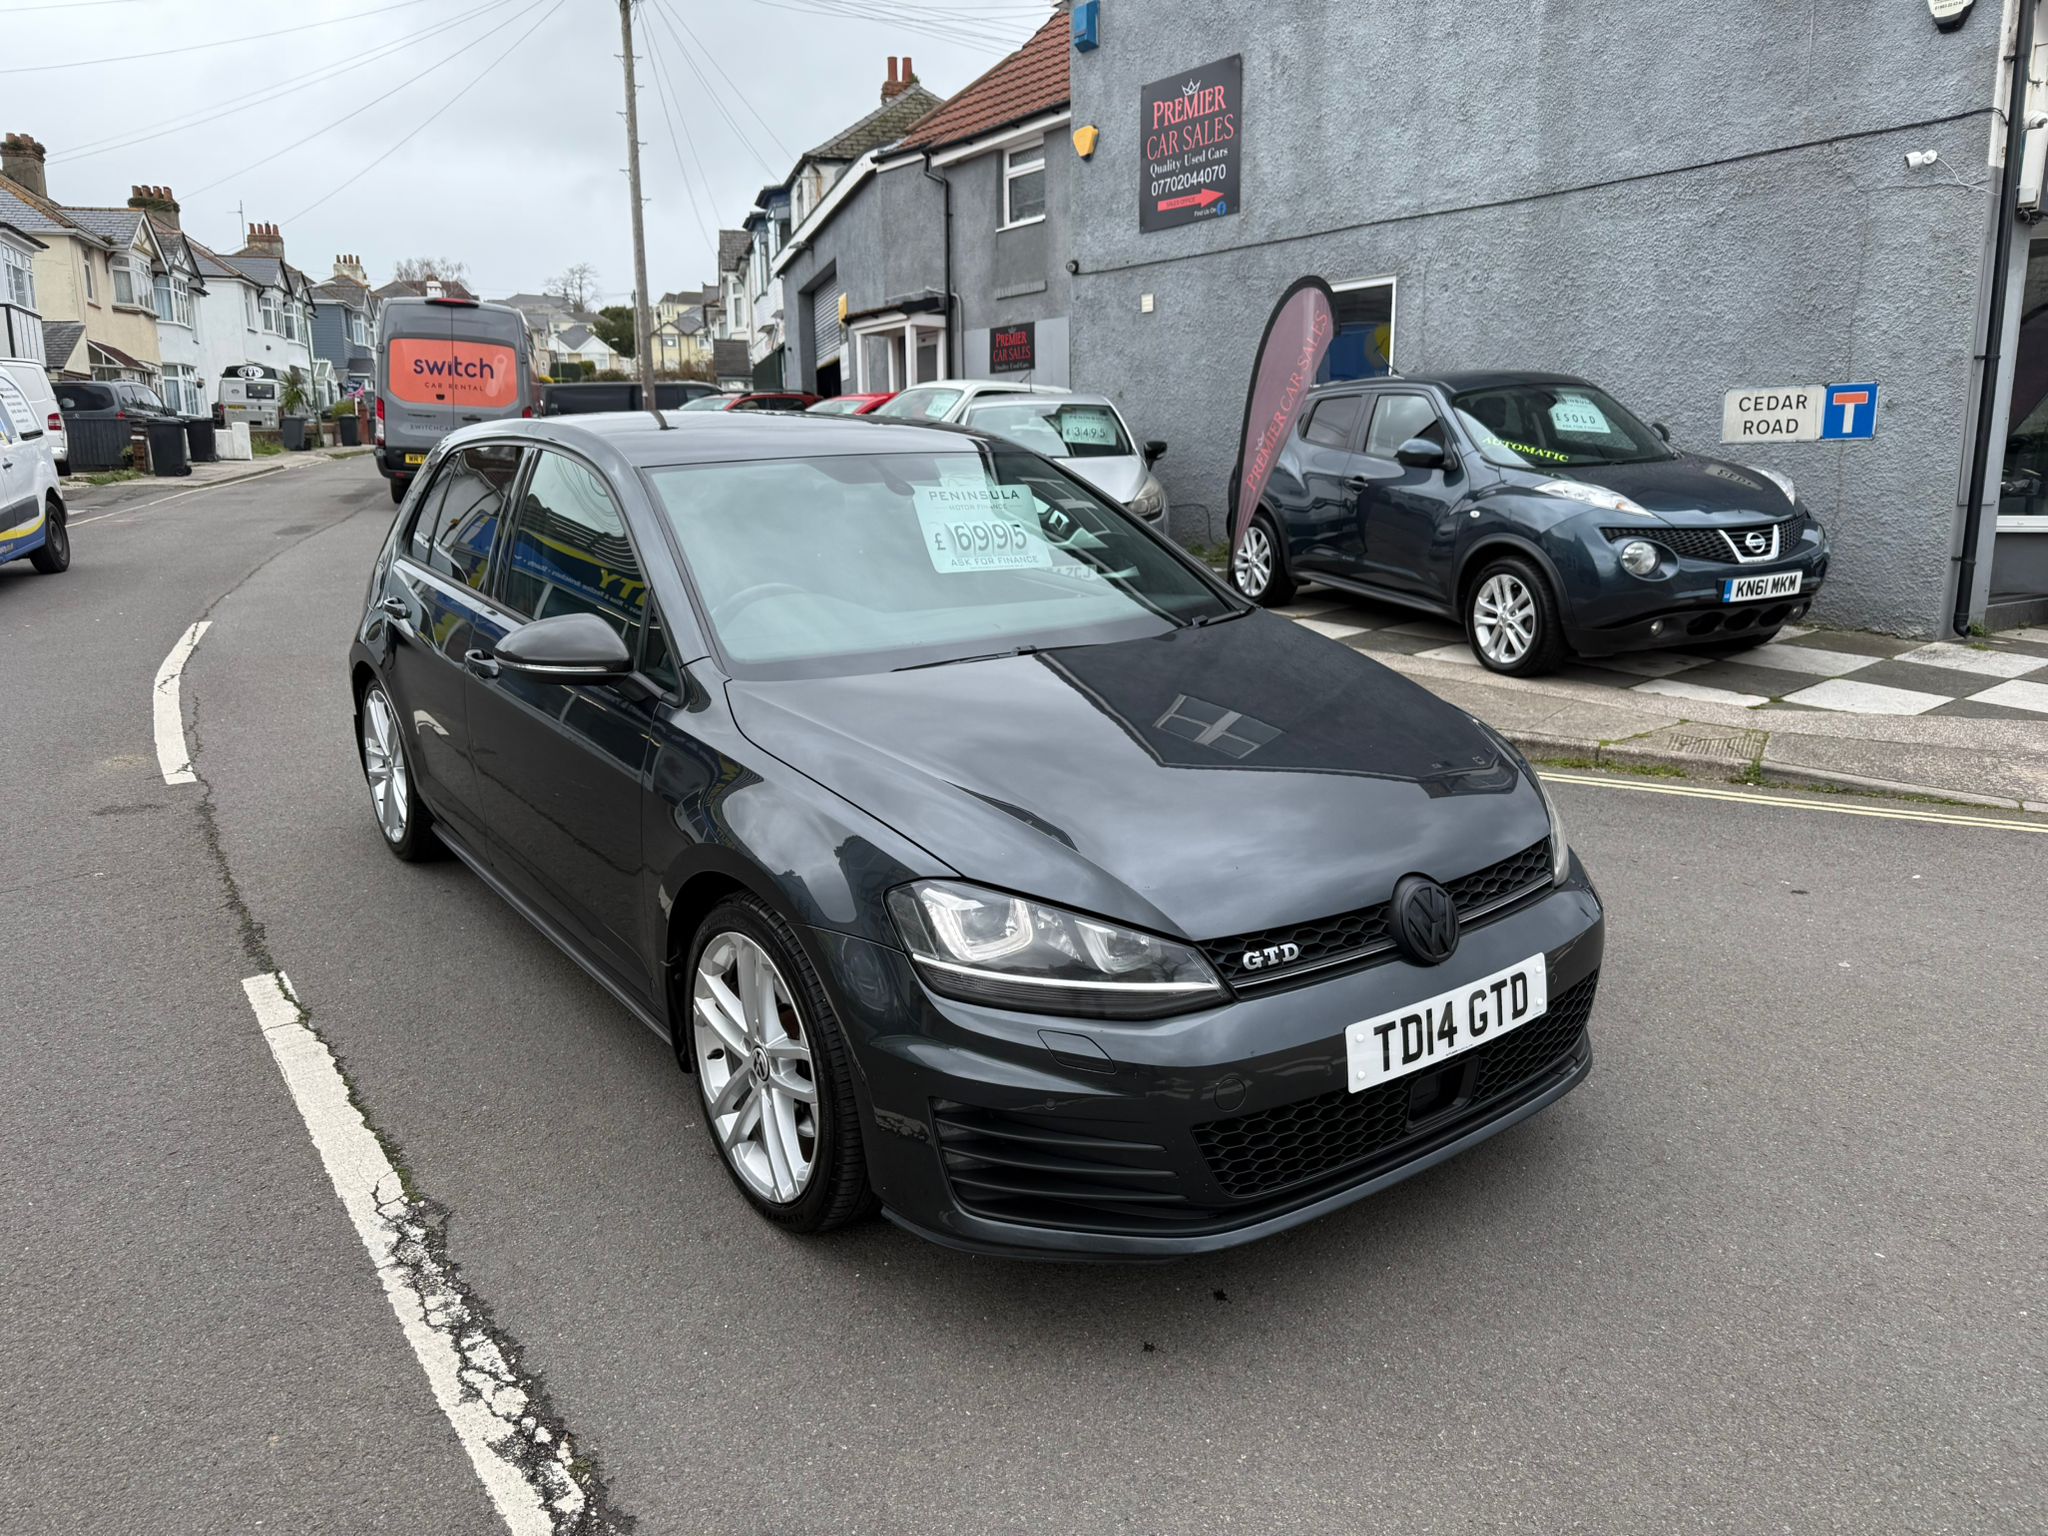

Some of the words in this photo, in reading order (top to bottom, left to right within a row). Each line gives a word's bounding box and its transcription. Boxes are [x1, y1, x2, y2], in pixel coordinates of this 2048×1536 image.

[1153, 85, 1227, 130] PREMIER
[1147, 130, 1179, 160] CAR
[1183, 113, 1234, 151] SALES
[1150, 159, 1182, 178] Quality
[1184, 149, 1206, 167] Used
[1207, 147, 1229, 160] Cars
[1151, 163, 1226, 197] 07702044070
[995, 331, 1027, 348] PREMIER
[993, 349, 1008, 362] CAR
[1009, 345, 1031, 361] SALES
[413, 356, 495, 379] switch
[448, 383, 484, 392] RENTAL
[1246, 410, 1287, 492] PREMIER
[1280, 372, 1303, 412] CAR
[1297, 311, 1329, 369] SALES
[1738, 394, 1808, 412] CEDAR
[1564, 413, 1596, 424] SOLD
[1743, 418, 1799, 435] ROAD
[1074, 426, 1106, 439] 3495
[1482, 436, 1569, 463] AUTOMATIC
[928, 489, 1020, 501] PENINSULA
[934, 532, 946, 551] £
[953, 522, 1028, 552] 6995
[951, 556, 971, 567] ASK
[974, 556, 995, 566] FOR
[997, 555, 1039, 565] FINANCE
[1735, 577, 1769, 598] KN61
[1770, 574, 1798, 596] MKM
[1242, 942, 1300, 971] GTD
[1373, 1000, 1458, 1073] TD14
[1468, 971, 1528, 1038] GTD
